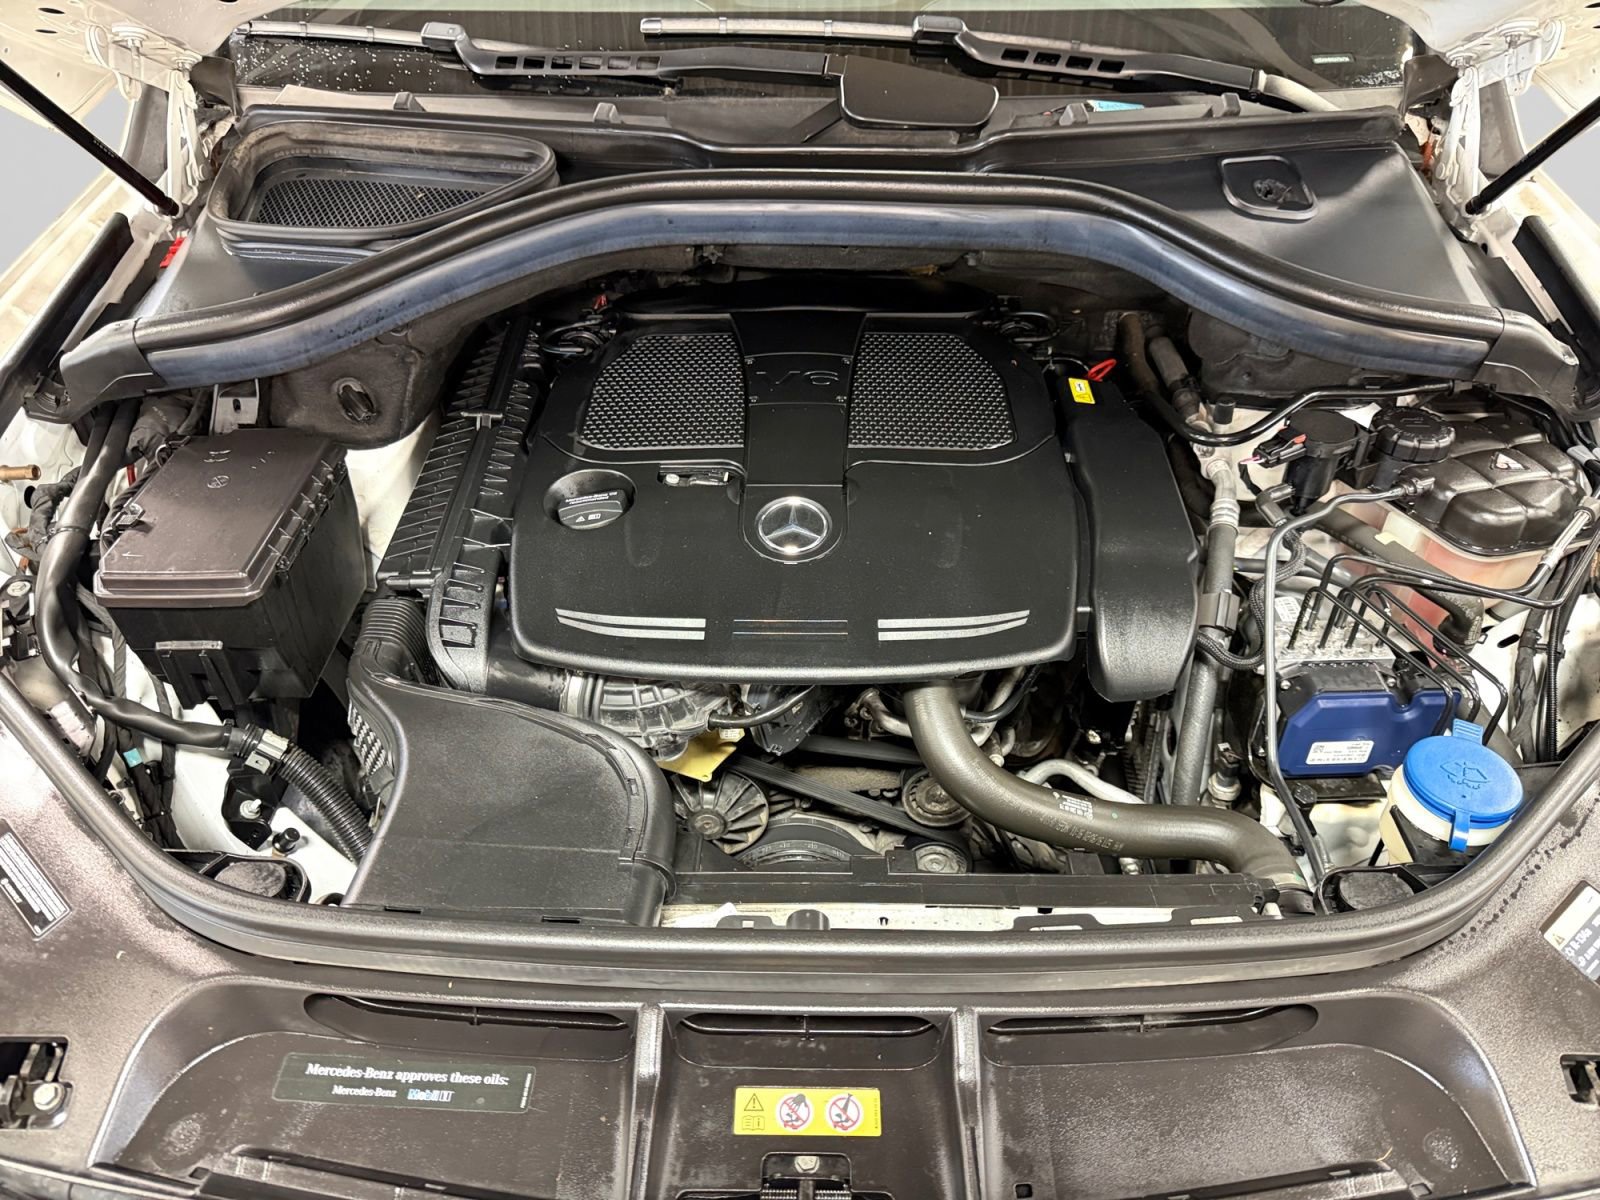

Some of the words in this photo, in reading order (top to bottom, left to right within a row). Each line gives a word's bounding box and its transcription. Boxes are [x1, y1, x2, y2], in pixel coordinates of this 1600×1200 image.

[306, 1063, 394, 1080] Mercedes-Benz
[394, 1071, 448, 1084] approves
[450, 1072, 482, 1084] these
[483, 1074, 509, 1086] oils:
[332, 1085, 397, 1098] Mercedes-Benz
